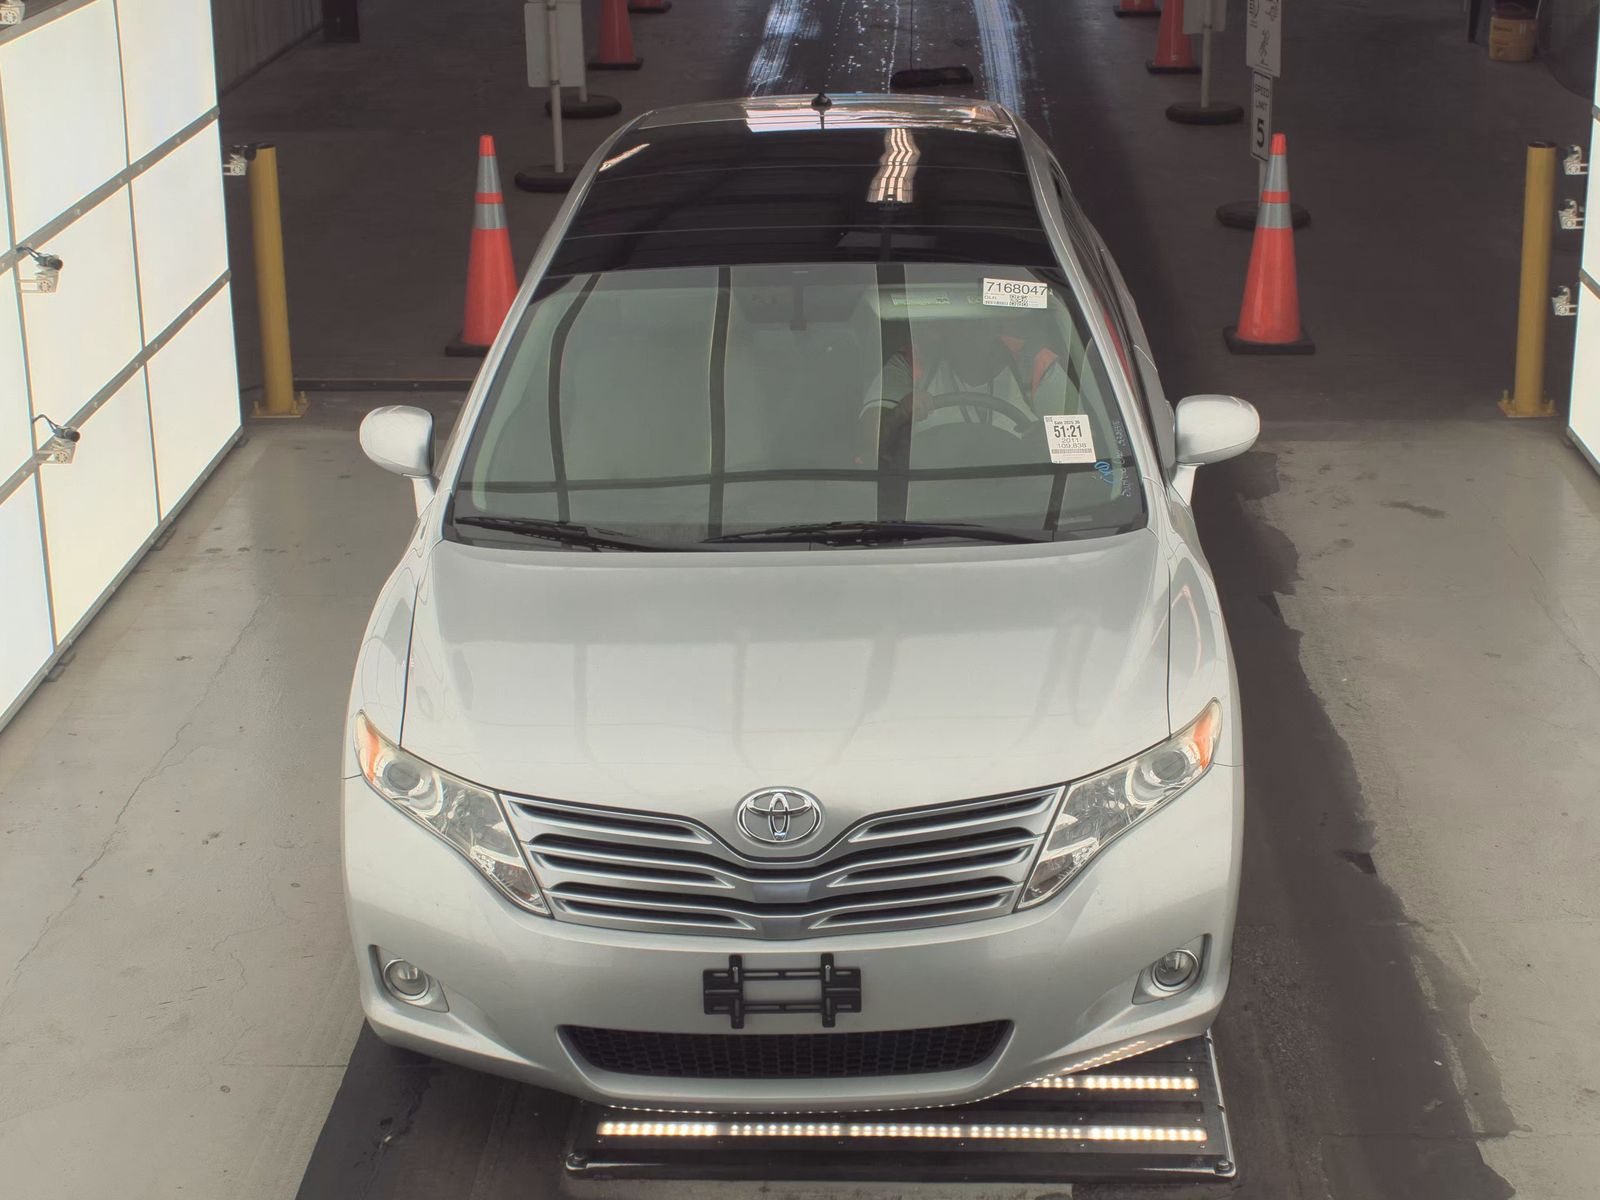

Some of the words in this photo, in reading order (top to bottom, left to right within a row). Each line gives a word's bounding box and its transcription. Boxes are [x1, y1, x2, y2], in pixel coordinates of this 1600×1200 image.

[1254, 84, 1270, 98] SPEED
[1256, 118, 1266, 148] 5
[986, 281, 1048, 296] 7168047
[1053, 425, 1083, 438] 51:21
